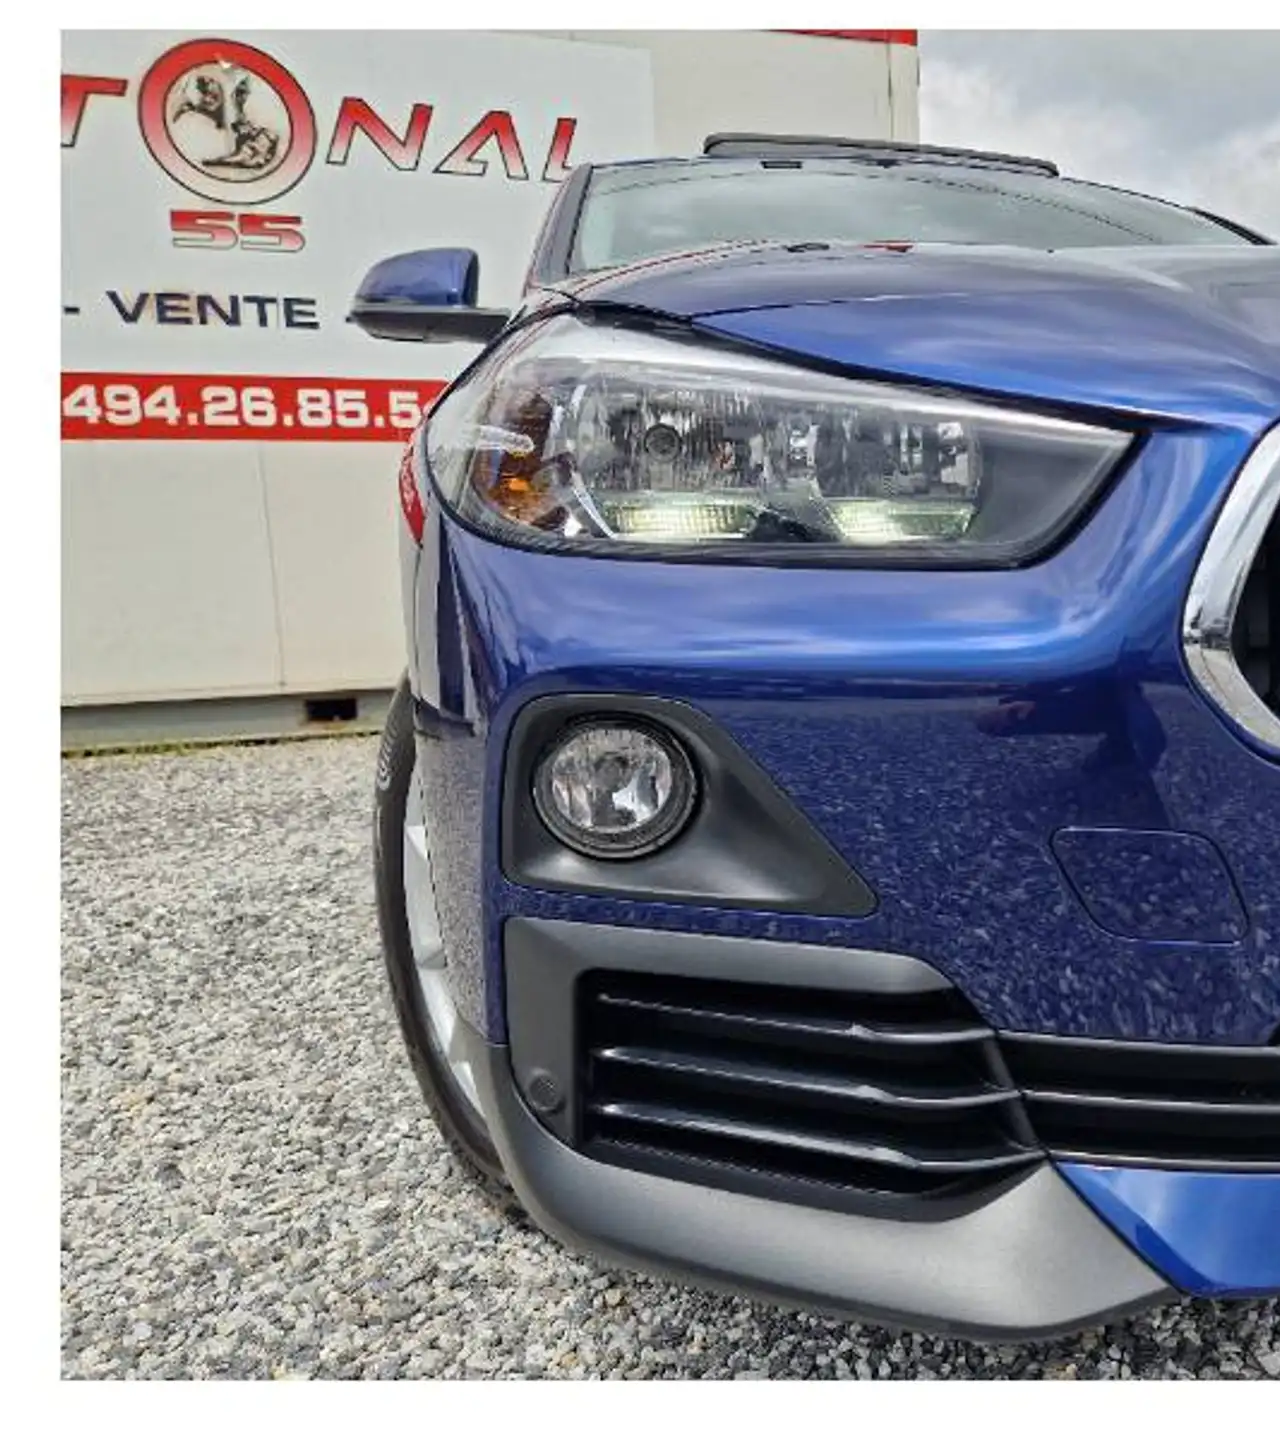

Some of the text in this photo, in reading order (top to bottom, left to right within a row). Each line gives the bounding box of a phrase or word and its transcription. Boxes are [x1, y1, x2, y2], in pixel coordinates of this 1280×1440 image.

[170, 209, 305, 253] 55
[106, 290, 320, 330] VENTE
[63, 383, 428, 429] 494.26.85.5
